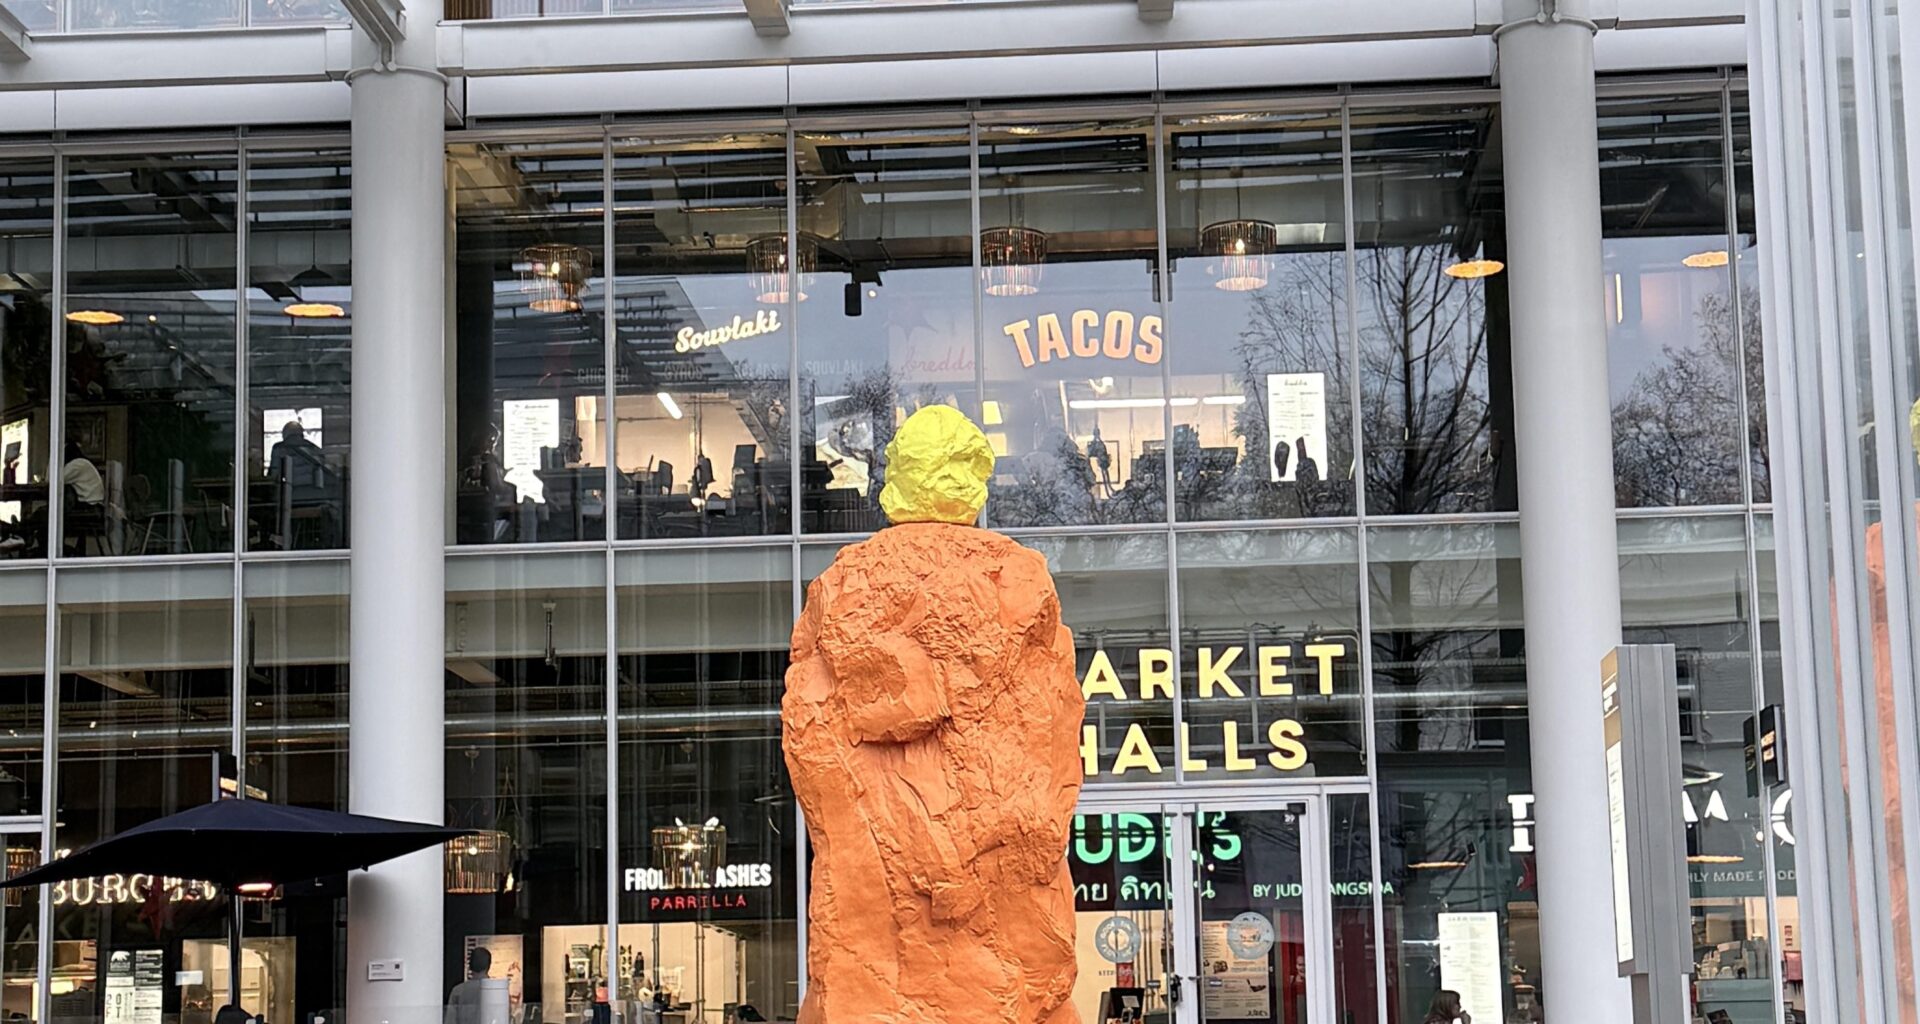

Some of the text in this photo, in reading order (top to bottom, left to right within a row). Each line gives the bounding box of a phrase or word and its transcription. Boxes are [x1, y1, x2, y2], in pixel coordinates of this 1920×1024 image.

[674, 310, 782, 353] Souvlaki
[1003, 309, 1163, 368] TACOS
[900, 347, 988, 375] breddo
[1080, 643, 1346, 700] ARKET
[714, 863, 772, 889] ASHES
[1713, 870, 1755, 882] MADE
[650, 894, 747, 910] PARRILLA
[1252, 884, 1271, 898] BY
[1275, 883, 1303, 900] JUD
